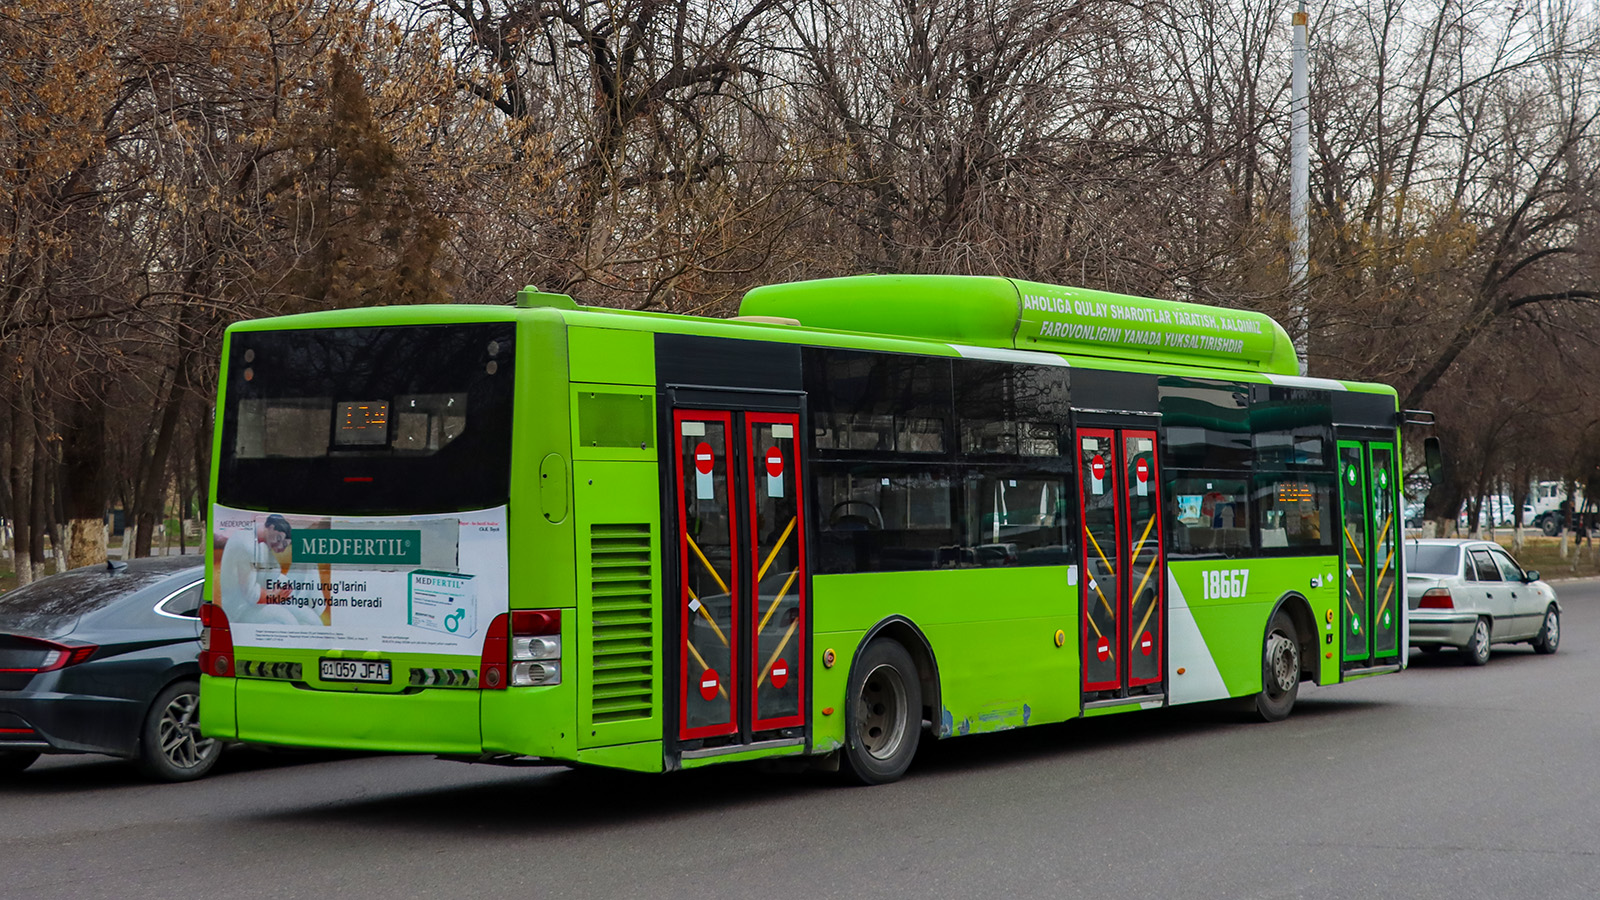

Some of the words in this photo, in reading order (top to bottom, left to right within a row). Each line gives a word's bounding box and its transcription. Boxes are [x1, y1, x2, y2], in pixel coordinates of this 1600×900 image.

[1024, 295, 1072, 314] AHOLIGA
[1075, 301, 1107, 318] QULAY
[1110, 304, 1172, 324] SHAROITLAR
[1172, 311, 1219, 331] YARATISH,
[1220, 317, 1262, 334] XALQIMIZ
[1040, 321, 1121, 342] FAROVONLIGINI
[1123, 329, 1161, 345] YANADA
[1164, 332, 1244, 353] YUKSALTIRISHDIR
[220, 520, 253, 528] MEDEXPORT
[266, 579, 314, 591] Erkaklarni
[317, 581, 367, 594] urug'larini
[1202, 569, 1249, 600] 18667
[266, 594, 309, 608] tiklashga
[311, 597, 348, 609] yordam
[351, 597, 382, 608] beradi
[323, 663, 333, 675] 01
[336, 662, 357, 678] 059
[360, 663, 384, 679] JFA
